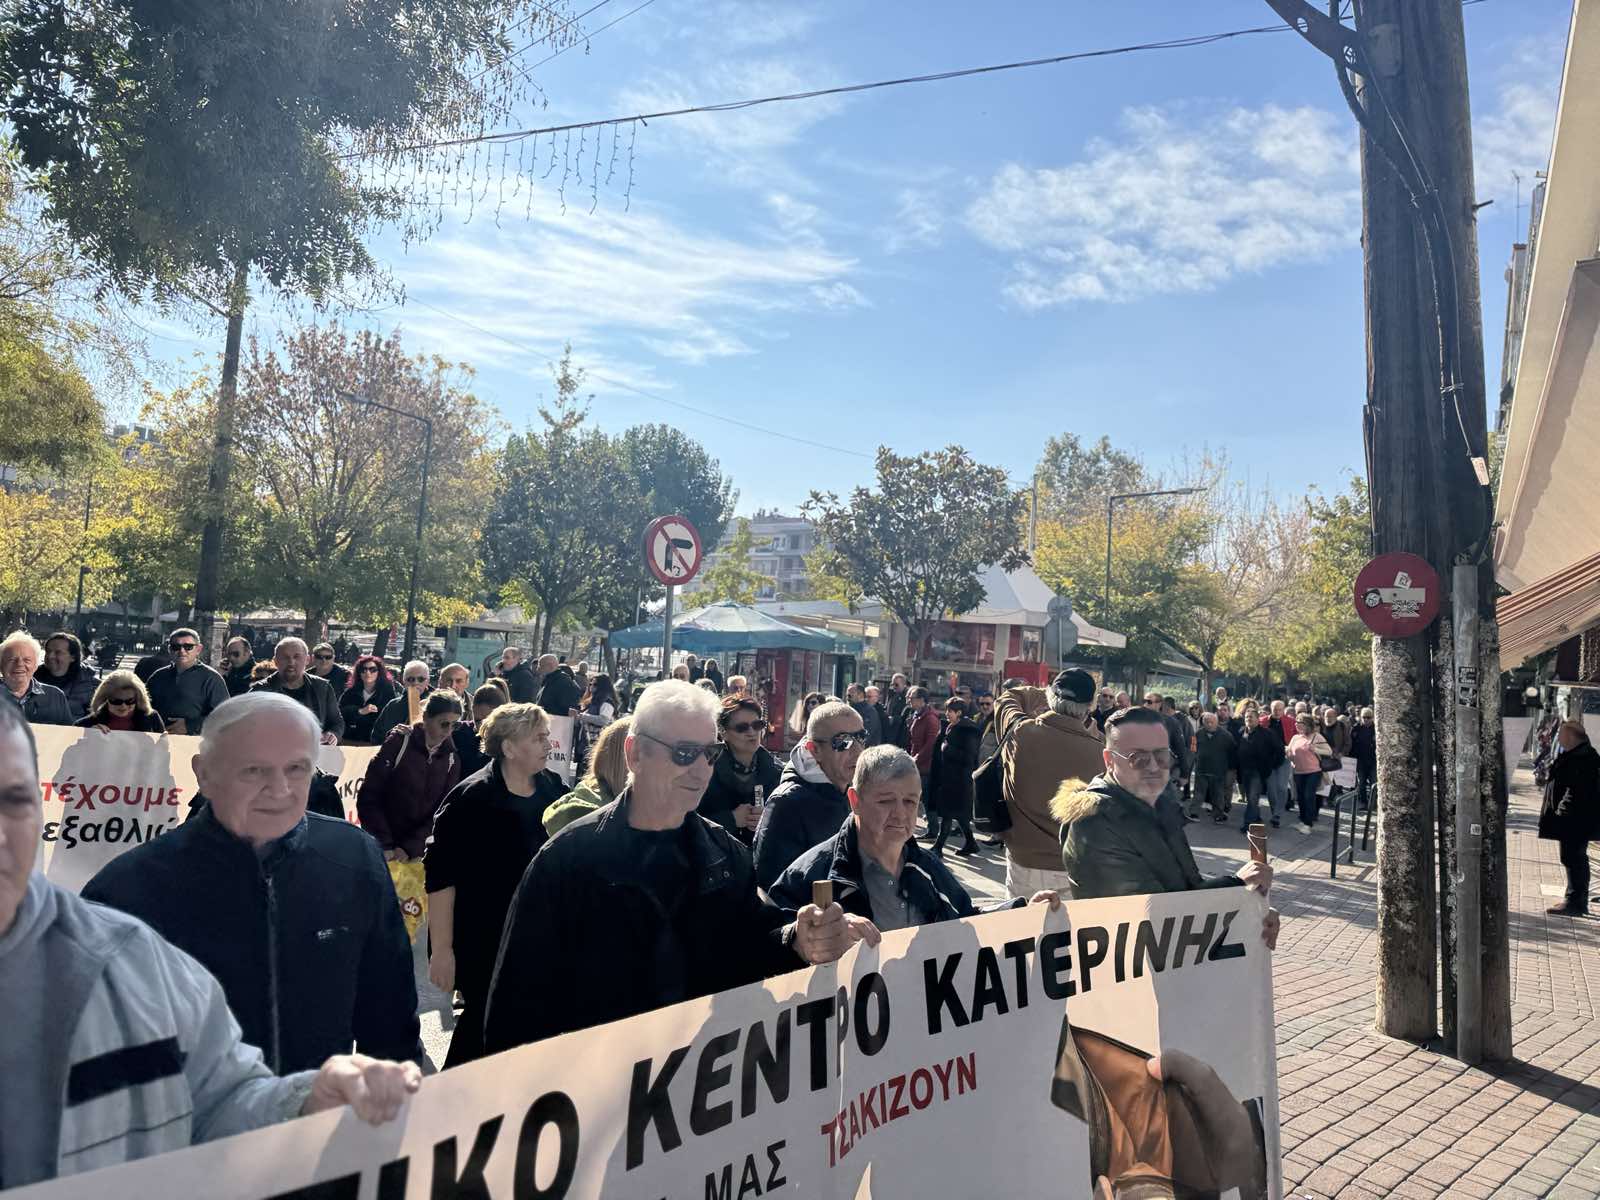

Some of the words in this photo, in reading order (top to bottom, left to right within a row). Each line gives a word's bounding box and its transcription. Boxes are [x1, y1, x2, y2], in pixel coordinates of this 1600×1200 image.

[626, 971, 891, 1172] ΚΕΝΤΡΟ
[923, 909, 1247, 1036] ΚΑΤΕΡΙΝΗΣ
[703, 1138, 788, 1200] ΜΑΣ
[820, 1051, 977, 1169] ΤΣΑΚΙΖΟΥΝ
